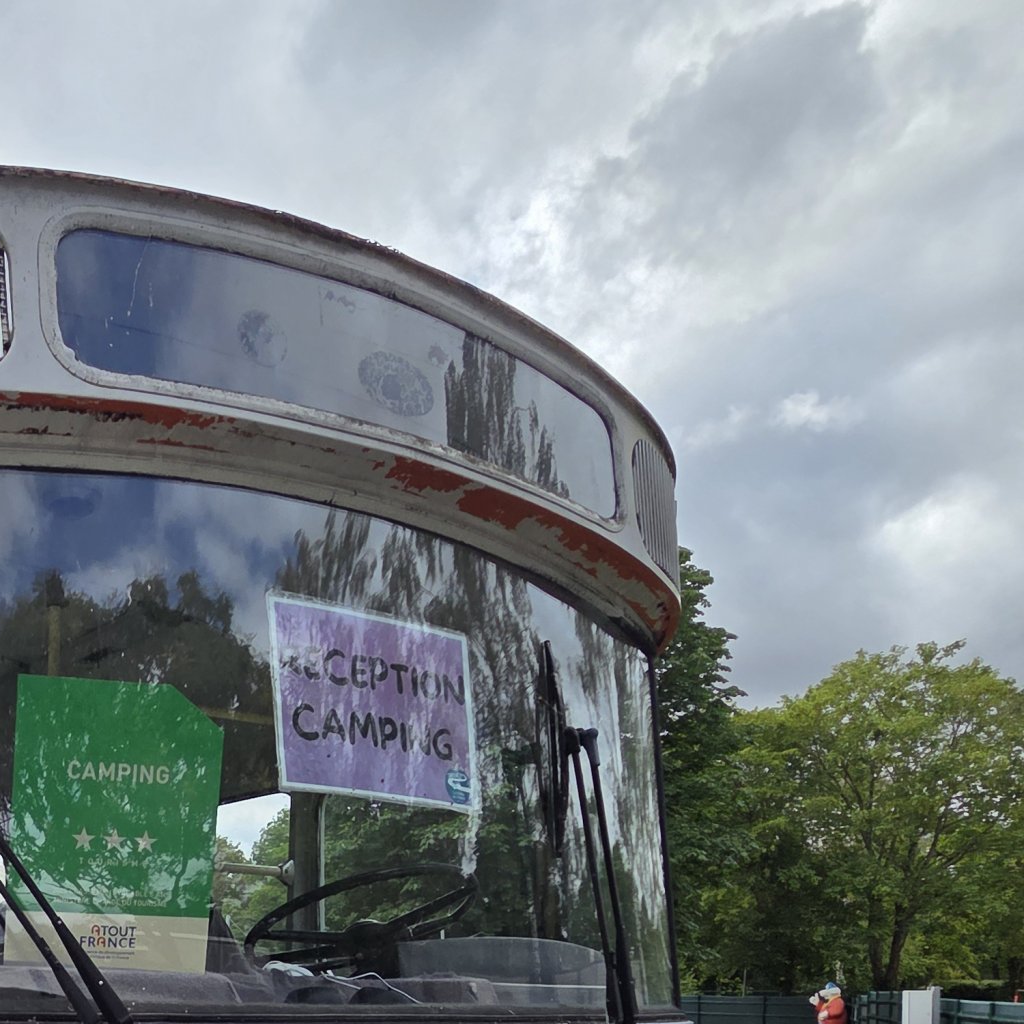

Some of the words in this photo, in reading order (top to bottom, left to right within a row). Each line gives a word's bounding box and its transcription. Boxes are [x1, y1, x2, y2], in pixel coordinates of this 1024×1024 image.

[291, 702, 454, 761] CAMPING
[66, 759, 170, 785] CAMPING
[91, 924, 137, 938] ATOUT
[79, 935, 137, 949] FRANCE
